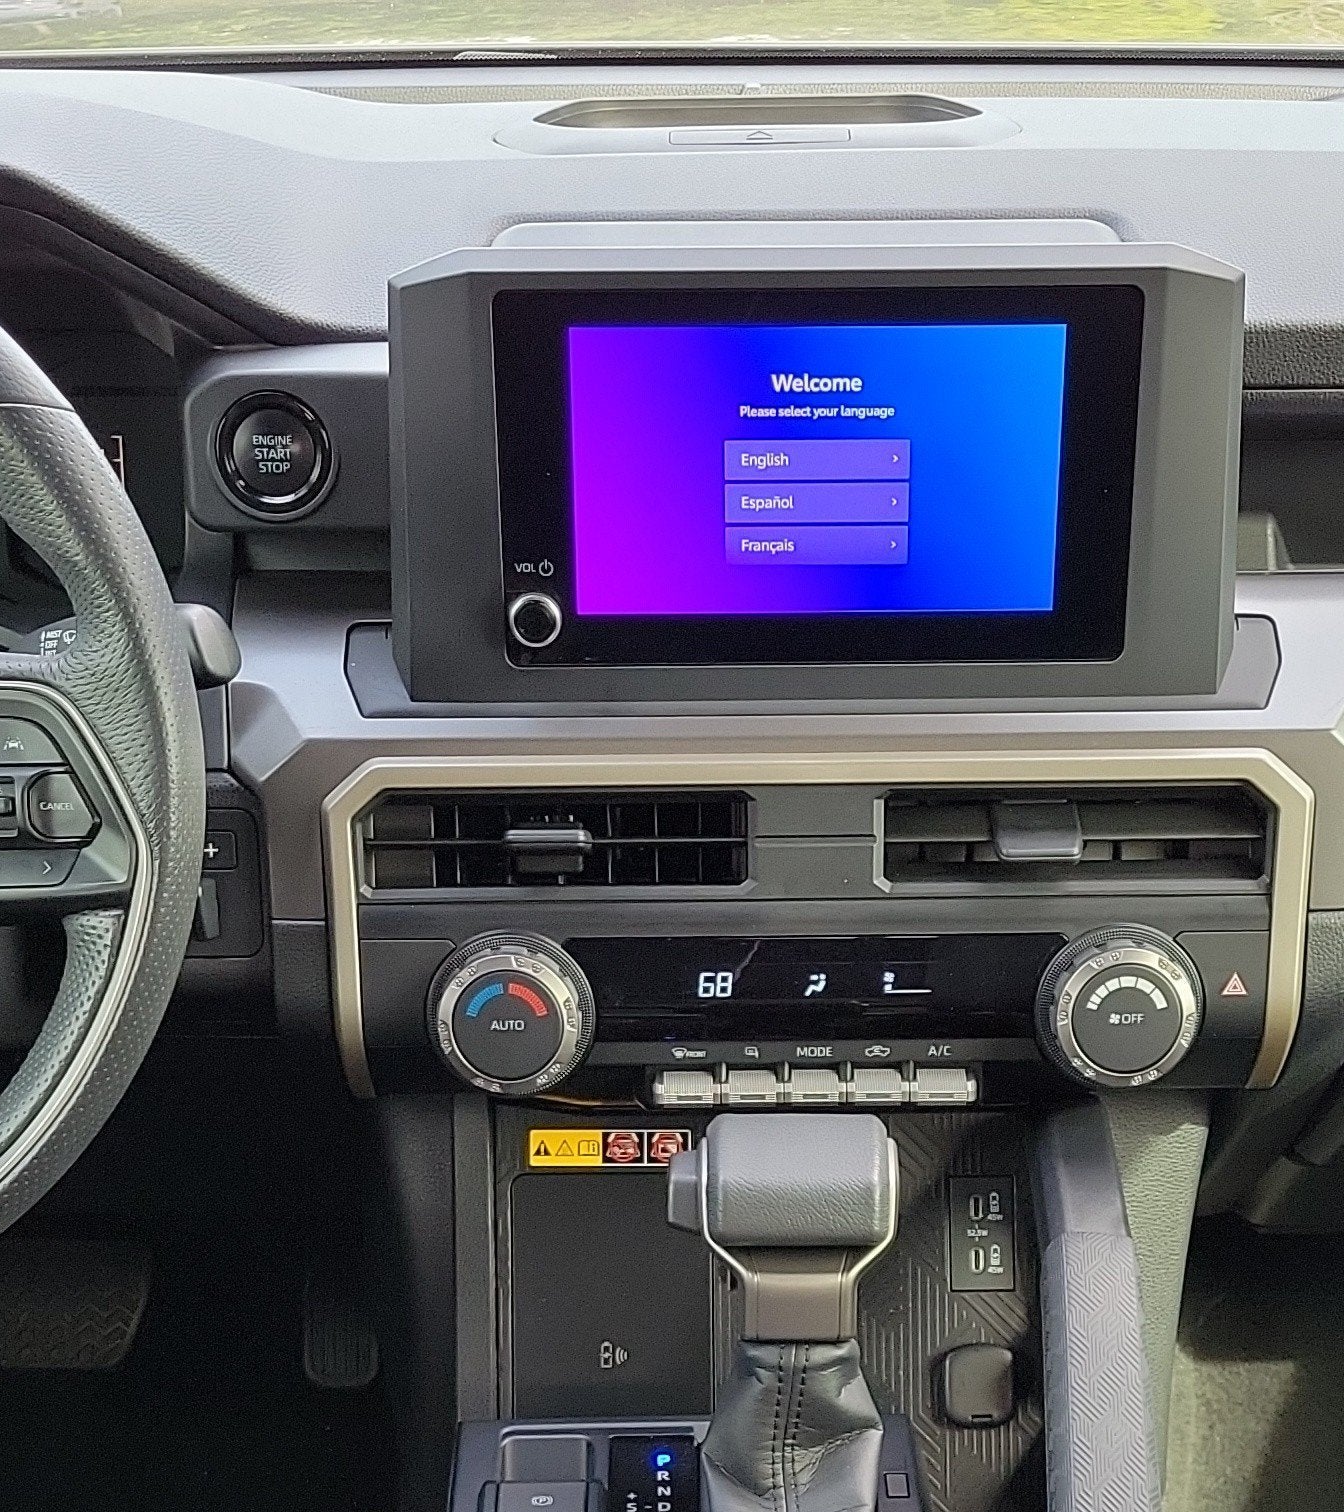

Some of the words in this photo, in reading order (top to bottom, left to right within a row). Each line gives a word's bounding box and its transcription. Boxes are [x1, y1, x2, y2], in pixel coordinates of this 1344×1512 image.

[770, 373, 863, 393] Welcome
[739, 405, 777, 418] Please
[778, 405, 811, 418] select
[812, 406, 839, 420] your
[840, 405, 895, 419] language
[252, 434, 293, 445] ENGINE
[254, 447, 291, 460] START
[258, 461, 291, 473] STOP
[741, 453, 789, 469] English
[741, 495, 794, 512] Español
[741, 538, 795, 554] Français
[514, 562, 537, 573] VOL
[44, 639, 58, 649] OFF
[39, 801, 74, 811] CANCEL
[698, 971, 734, 998] 68
[1121, 1013, 1145, 1025] OFF
[490, 1020, 525, 1031] AUTO
[796, 1046, 834, 1058] MODE
[927, 1045, 953, 1057] A/C
[657, 1454, 671, 1467] P
[657, 1470, 671, 1481] R
[657, 1485, 672, 1497] N
[626, 1502, 638, 1512] S
[657, 1502, 672, 1512] D
